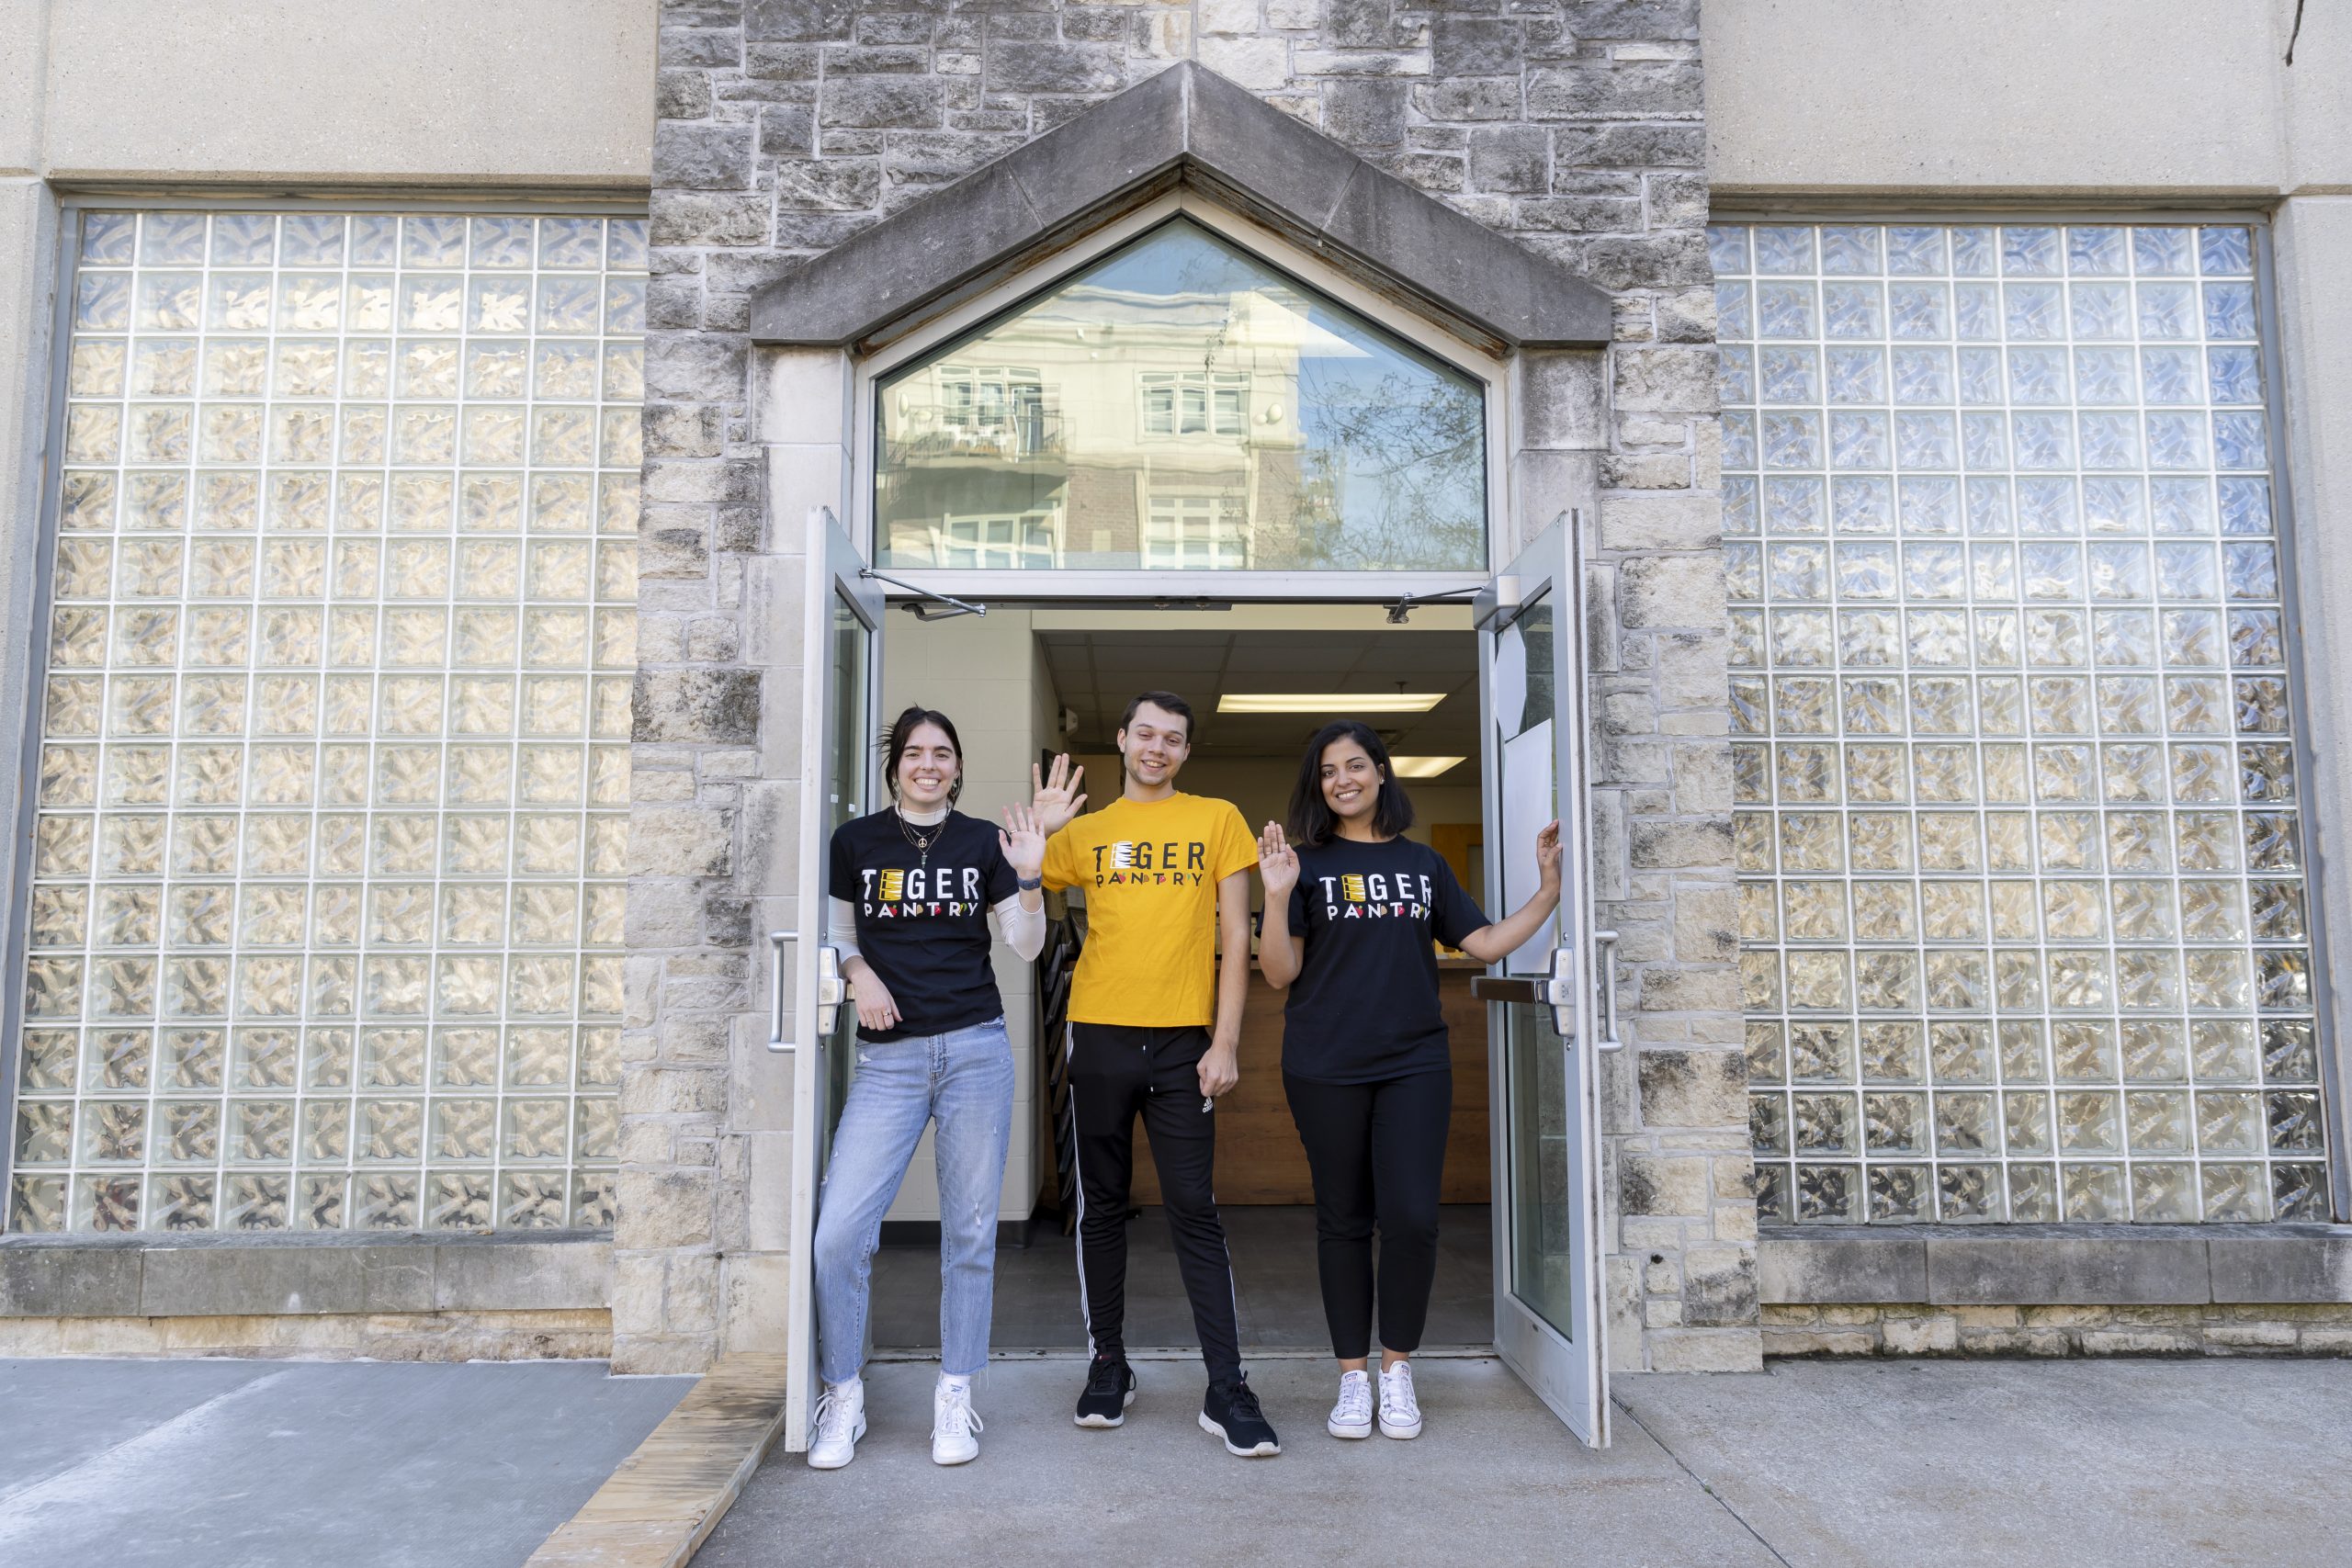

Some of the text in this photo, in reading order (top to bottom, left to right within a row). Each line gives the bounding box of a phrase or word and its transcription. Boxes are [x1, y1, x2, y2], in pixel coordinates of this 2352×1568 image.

[1096, 872, 1203, 888] PANTRY
[864, 902, 978, 918] PANTRY
[1327, 902, 1430, 920] PANTRY
